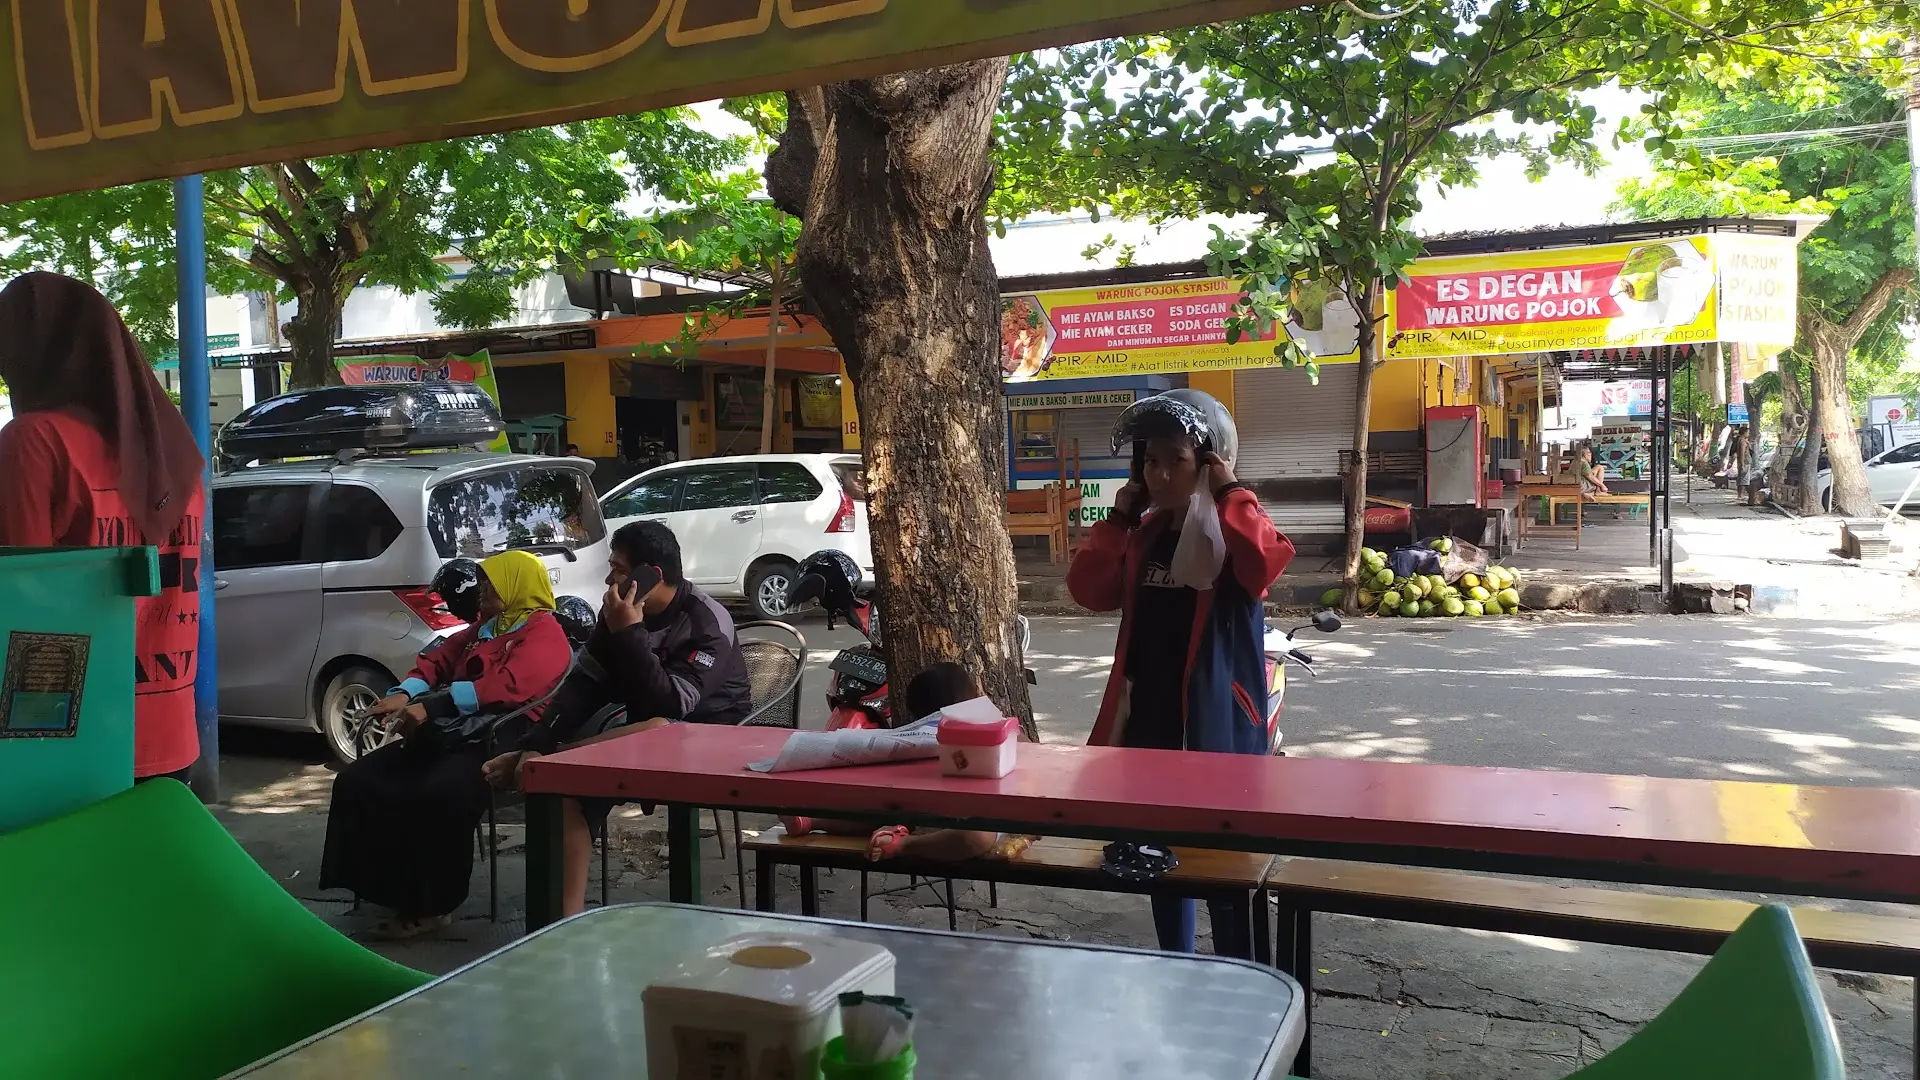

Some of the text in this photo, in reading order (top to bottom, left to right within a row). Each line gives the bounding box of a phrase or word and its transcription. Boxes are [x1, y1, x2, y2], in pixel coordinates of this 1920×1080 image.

[1096, 280, 1229, 300] WARUNG POJOK STASIUN
[1436, 270, 1582, 302] ES DEGAN
[1061, 308, 1155, 324] MIE AYAM BAKSO
[1169, 303, 1227, 317] ES DEGAN
[1425, 297, 1601, 325] WARUNG POJOK
[1061, 324, 1152, 340] MIE AYAM CEKER
[1169, 320, 1201, 332] SODA
[1125, 337, 1163, 346] MINUMAN
[1164, 334, 1189, 343] SEGAR
[1191, 332, 1227, 342] LAINNYA
[1130, 361, 1160, 371] #Alat
[1163, 359, 1189, 370] listrik
[364, 365, 417, 382] WARUNG
[1009, 397, 1020, 407] MIE
[1022, 397, 1038, 406] AYAM
[1040, 397, 1044, 405] &
[1046, 396, 1067, 405] BAKSO
[1072, 395, 1083, 404] MIE
[1085, 395, 1101, 404] AYAM
[1109, 393, 1131, 403] CEKER
[845, 421, 857, 434] 18
[605, 431, 614, 444] 19
